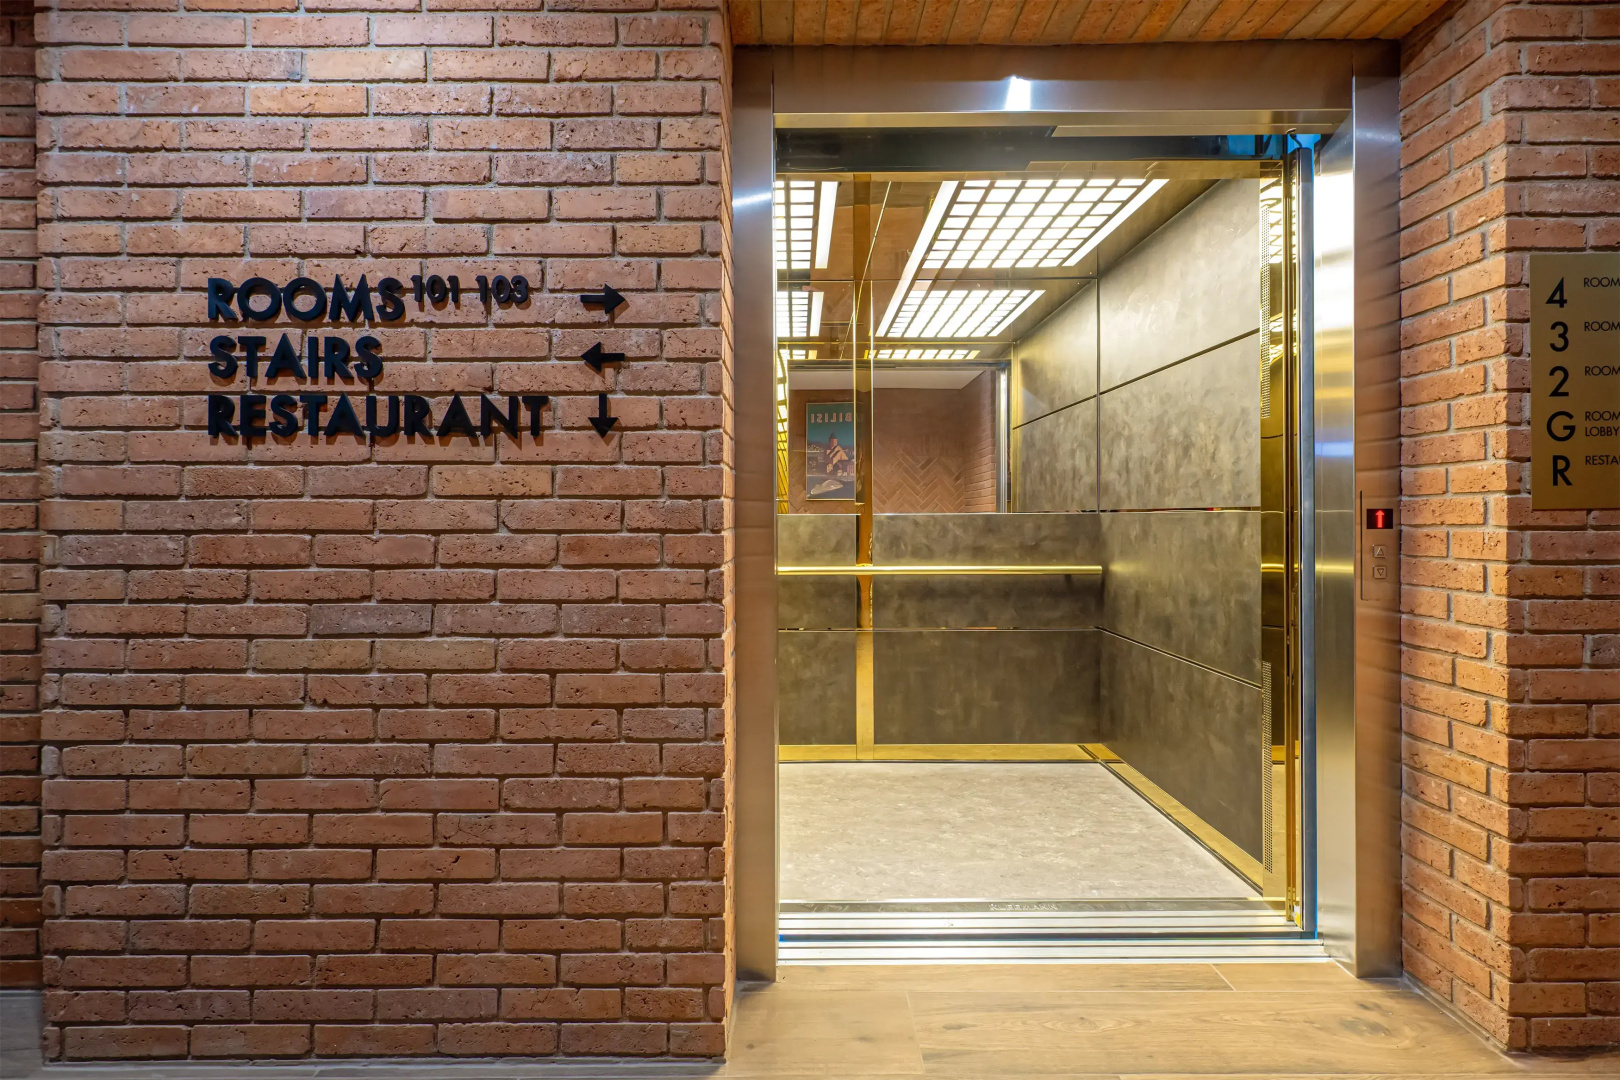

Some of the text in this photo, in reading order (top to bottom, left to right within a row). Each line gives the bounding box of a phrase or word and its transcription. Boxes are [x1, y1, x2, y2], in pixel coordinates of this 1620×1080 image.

[208, 274, 528, 321] ROOMS 101 103
[1545, 276, 1567, 308] 4
[1550, 321, 1569, 352] 3
[208, 333, 384, 379] STAIRS
[1549, 366, 1569, 397] 2
[208, 392, 549, 438] RESTAURANT
[1546, 411, 1576, 442] G
[1585, 426, 1620, 436] LOBBY
[1552, 455, 1620, 486] R RESTA
